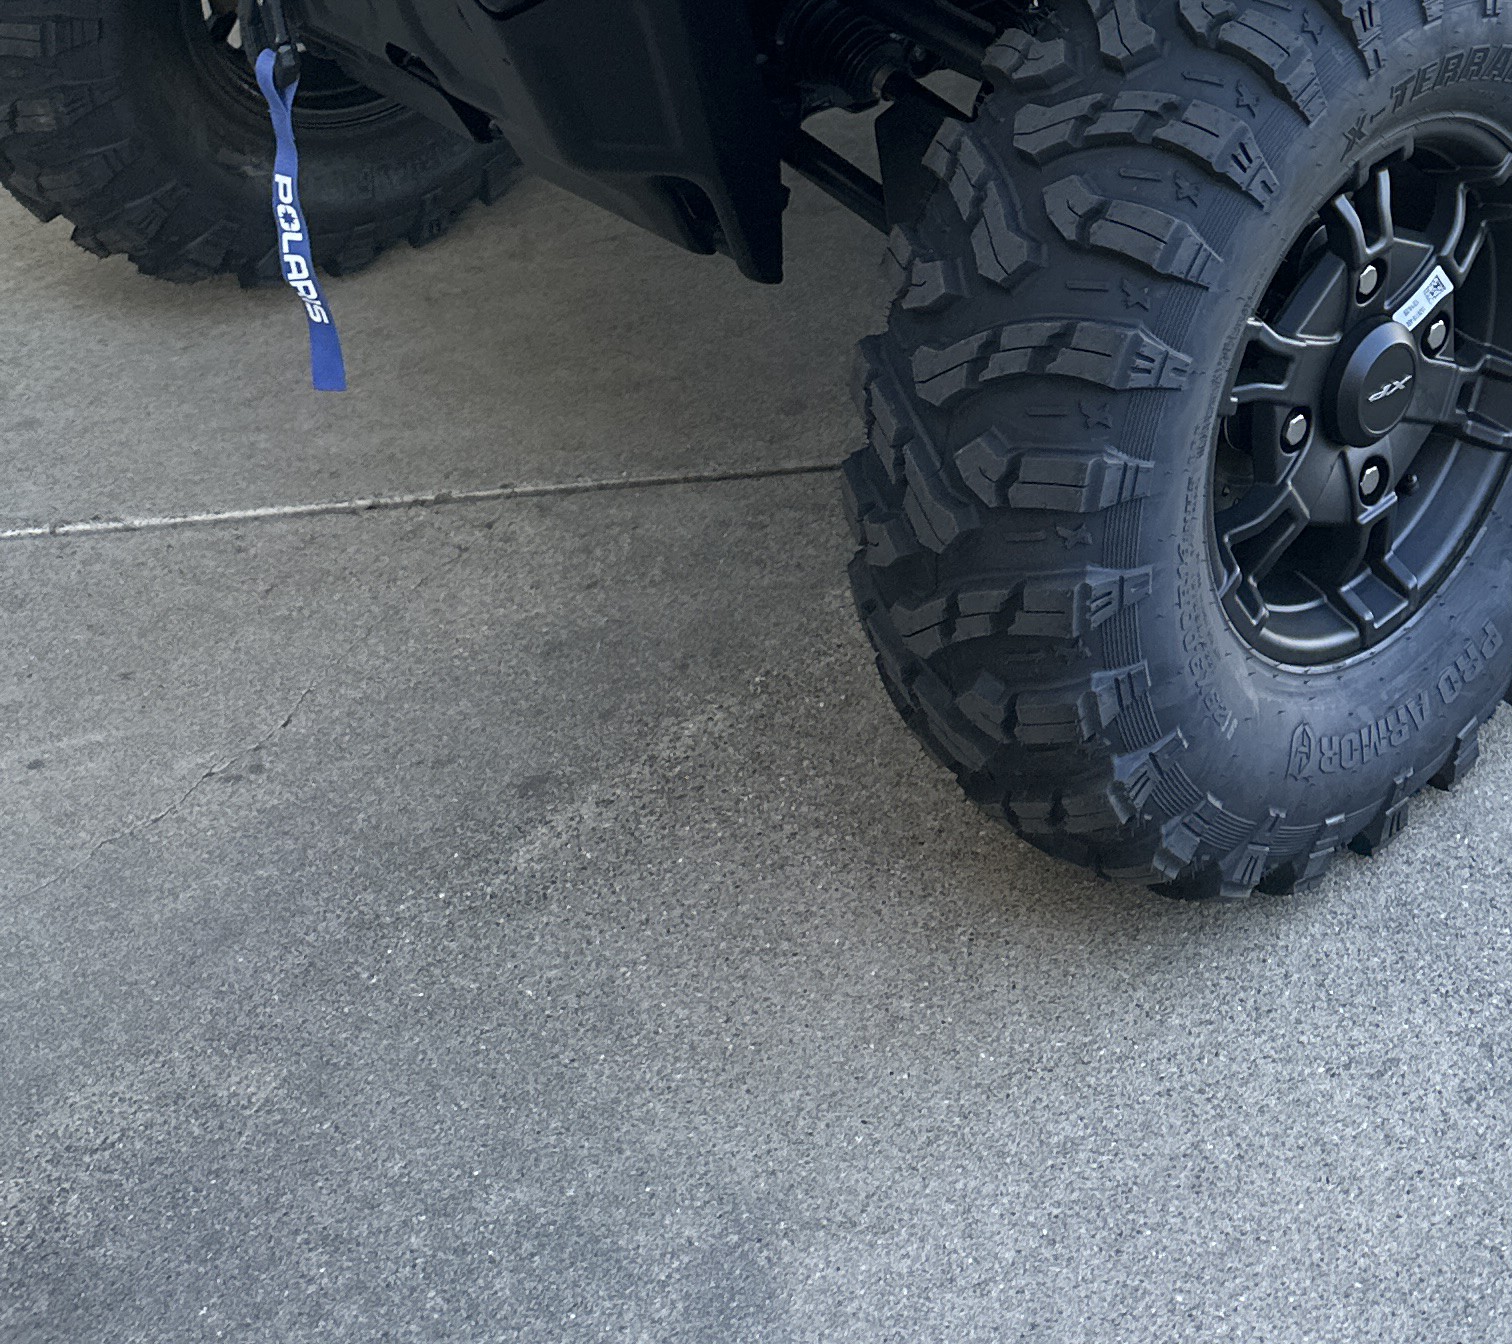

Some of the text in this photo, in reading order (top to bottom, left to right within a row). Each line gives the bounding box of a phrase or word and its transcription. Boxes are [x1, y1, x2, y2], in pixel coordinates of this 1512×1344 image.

[272, 173, 330, 325] POLARIS
[1319, 617, 1504, 775] PRO ARMOR
